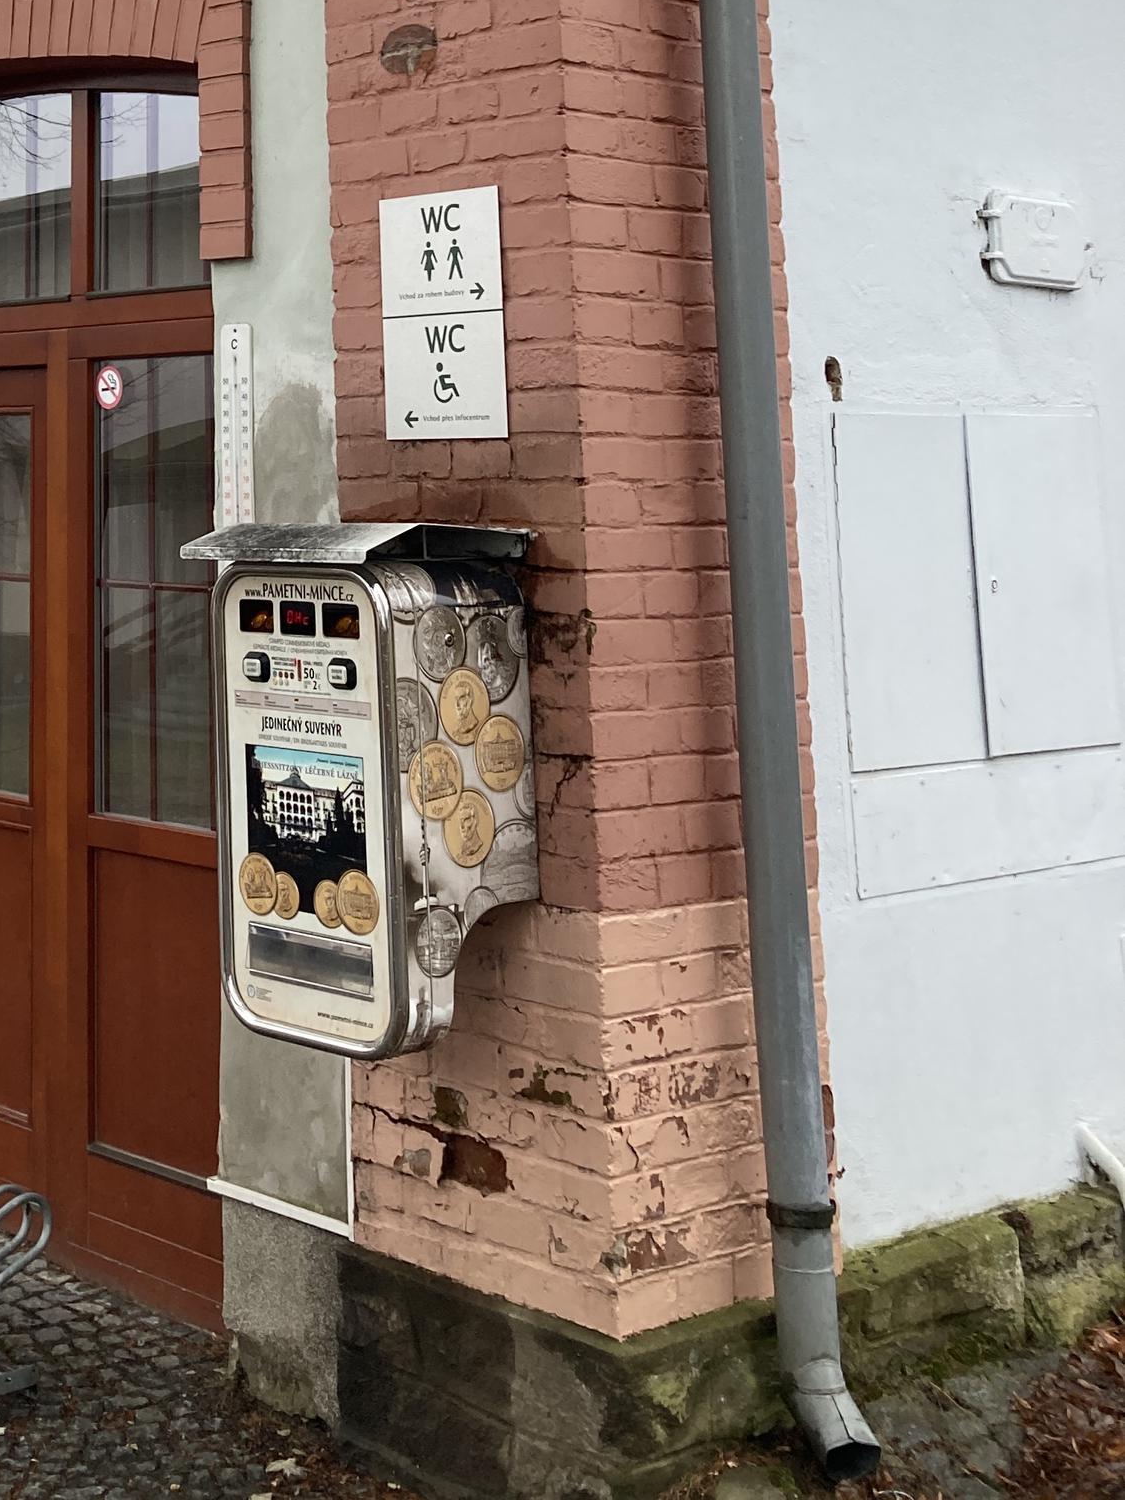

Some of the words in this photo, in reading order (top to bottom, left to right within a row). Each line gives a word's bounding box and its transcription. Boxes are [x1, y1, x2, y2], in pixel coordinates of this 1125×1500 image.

[421, 203, 461, 234] WC
[425, 324, 465, 354] WC
[423, 414, 441, 422] Vchod
[304, 667, 315, 679] 50
[313, 681, 317, 690] 2
[261, 716, 303, 732] JEDINEČNÝ
[305, 719, 342, 737] SUVENÝR
